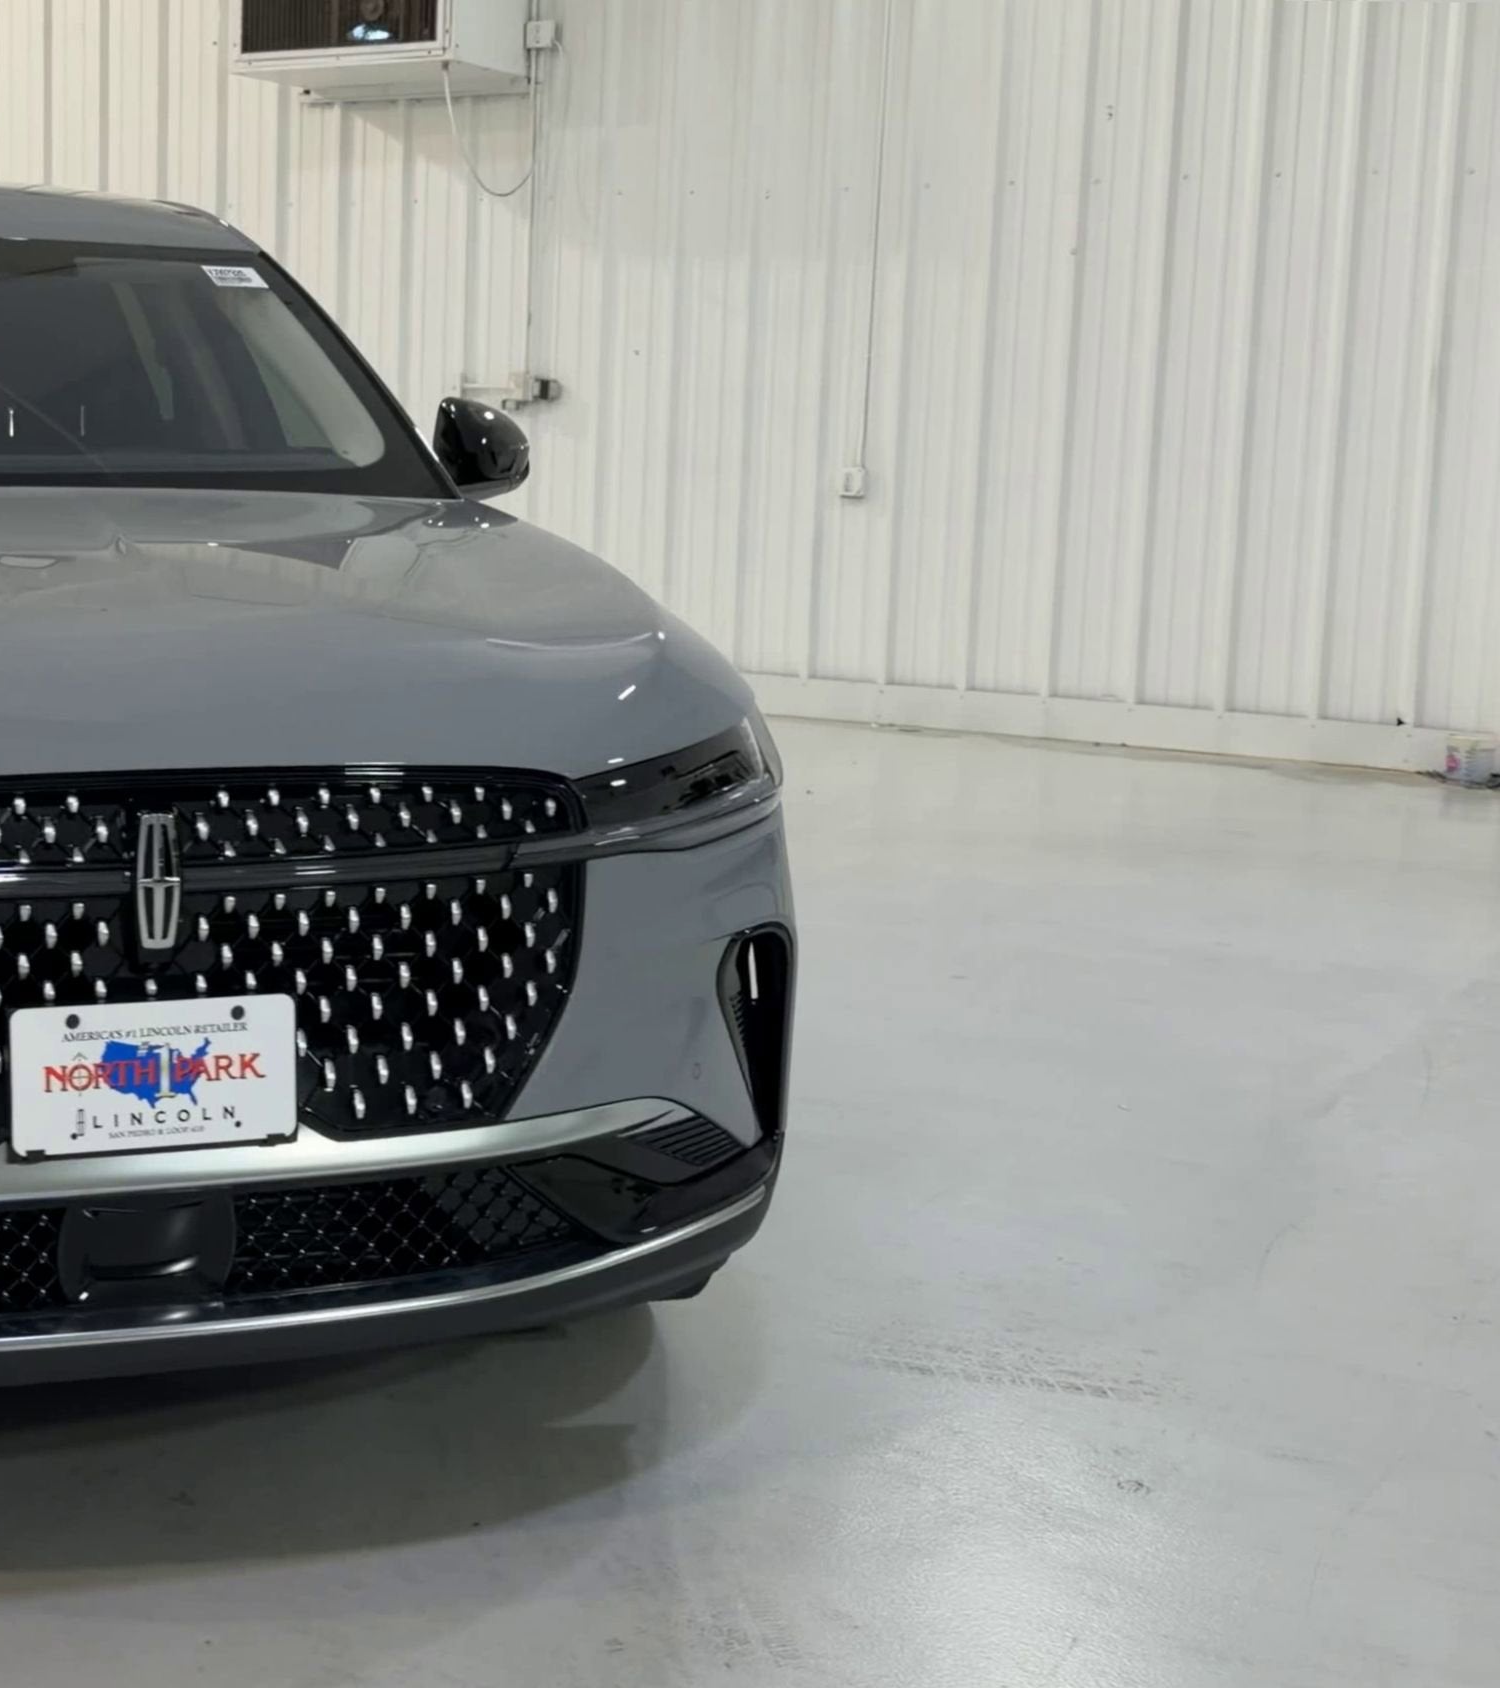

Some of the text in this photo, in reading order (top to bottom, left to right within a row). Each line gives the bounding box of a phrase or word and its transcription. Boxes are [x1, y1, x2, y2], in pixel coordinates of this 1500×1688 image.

[61, 1021, 248, 1043] AMERICA'S #1 LINCOLN RETAILER
[43, 1053, 266, 1092] NORTH PARK
[93, 1106, 236, 1129] LINCOLN
